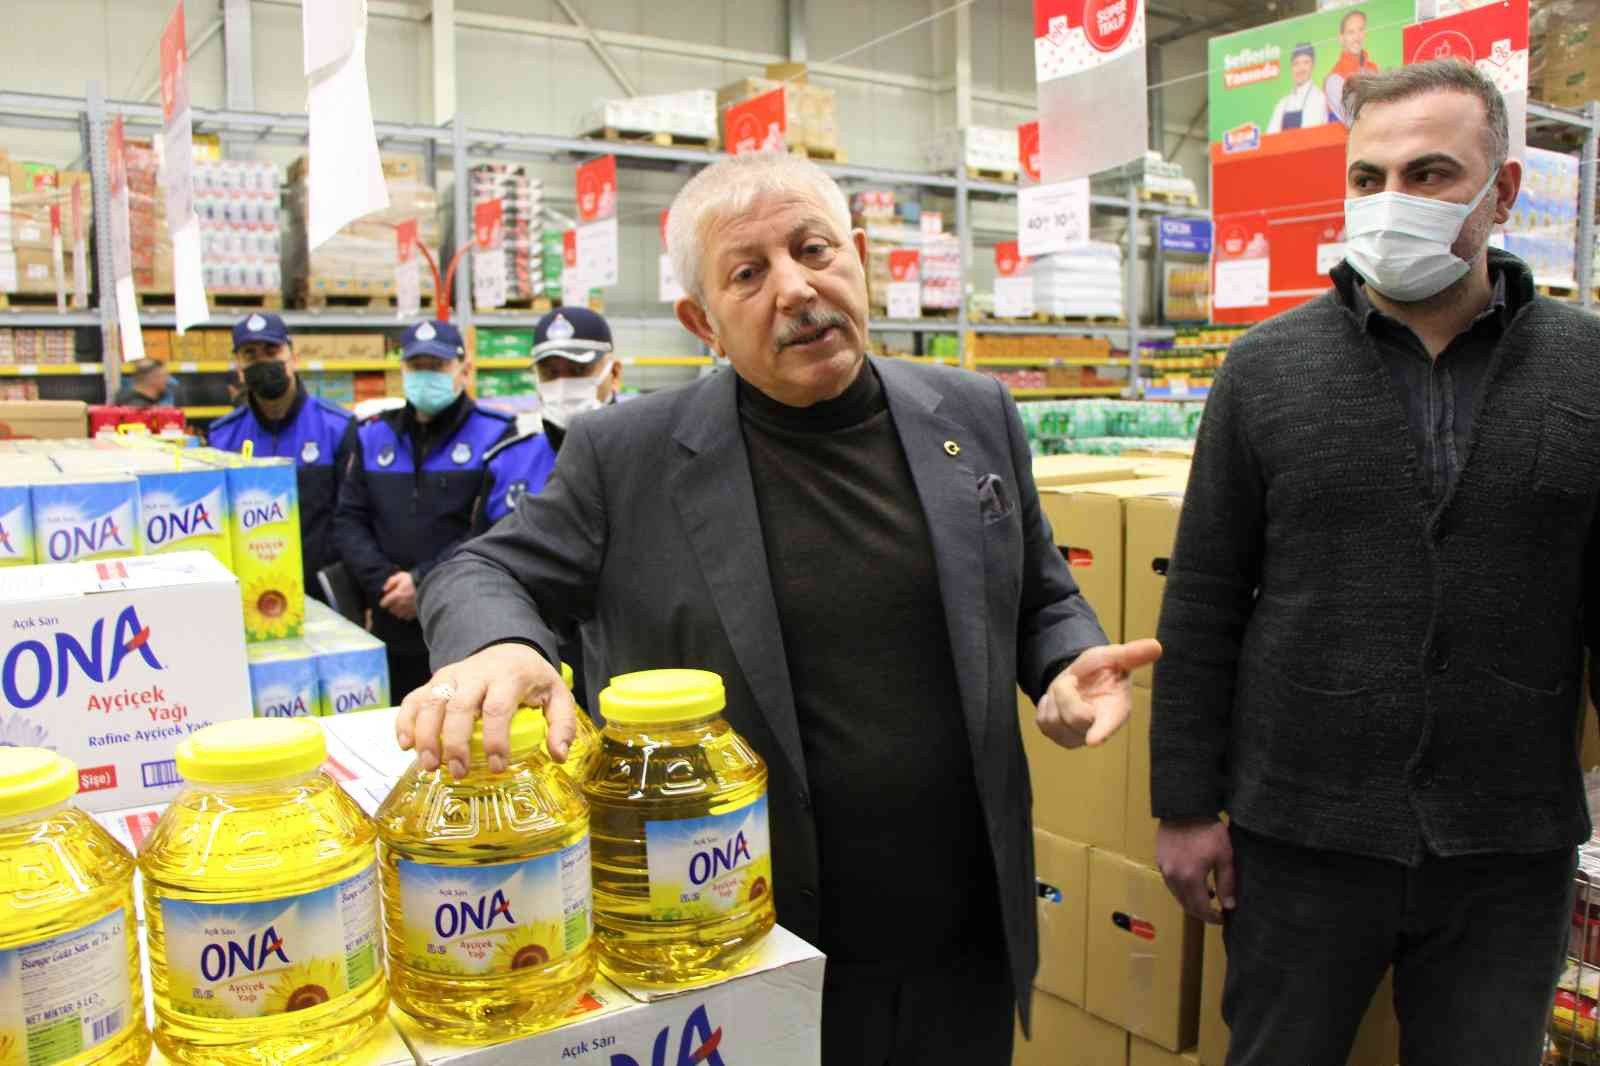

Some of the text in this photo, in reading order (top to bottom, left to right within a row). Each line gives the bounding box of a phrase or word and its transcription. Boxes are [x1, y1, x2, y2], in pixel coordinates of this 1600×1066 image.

[146, 502, 213, 544] ONA
[243, 501, 284, 528] ONA
[49, 516, 124, 561] ONA
[13, 617, 35, 630] Açık
[2, 605, 163, 709] ONA
[87, 685, 165, 713] Ayçiçek
[148, 703, 188, 722] Yağı
[265, 695, 308, 718] ONA
[336, 685, 377, 713] ONA
[88, 732, 131, 747] Rafine
[135, 724, 183, 741] Ayçiçek
[689, 830, 751, 885] ONA
[435, 889, 515, 938] ONA
[200, 925, 290, 982] ONA
[561, 1034, 616, 1060] Açık Sarı
